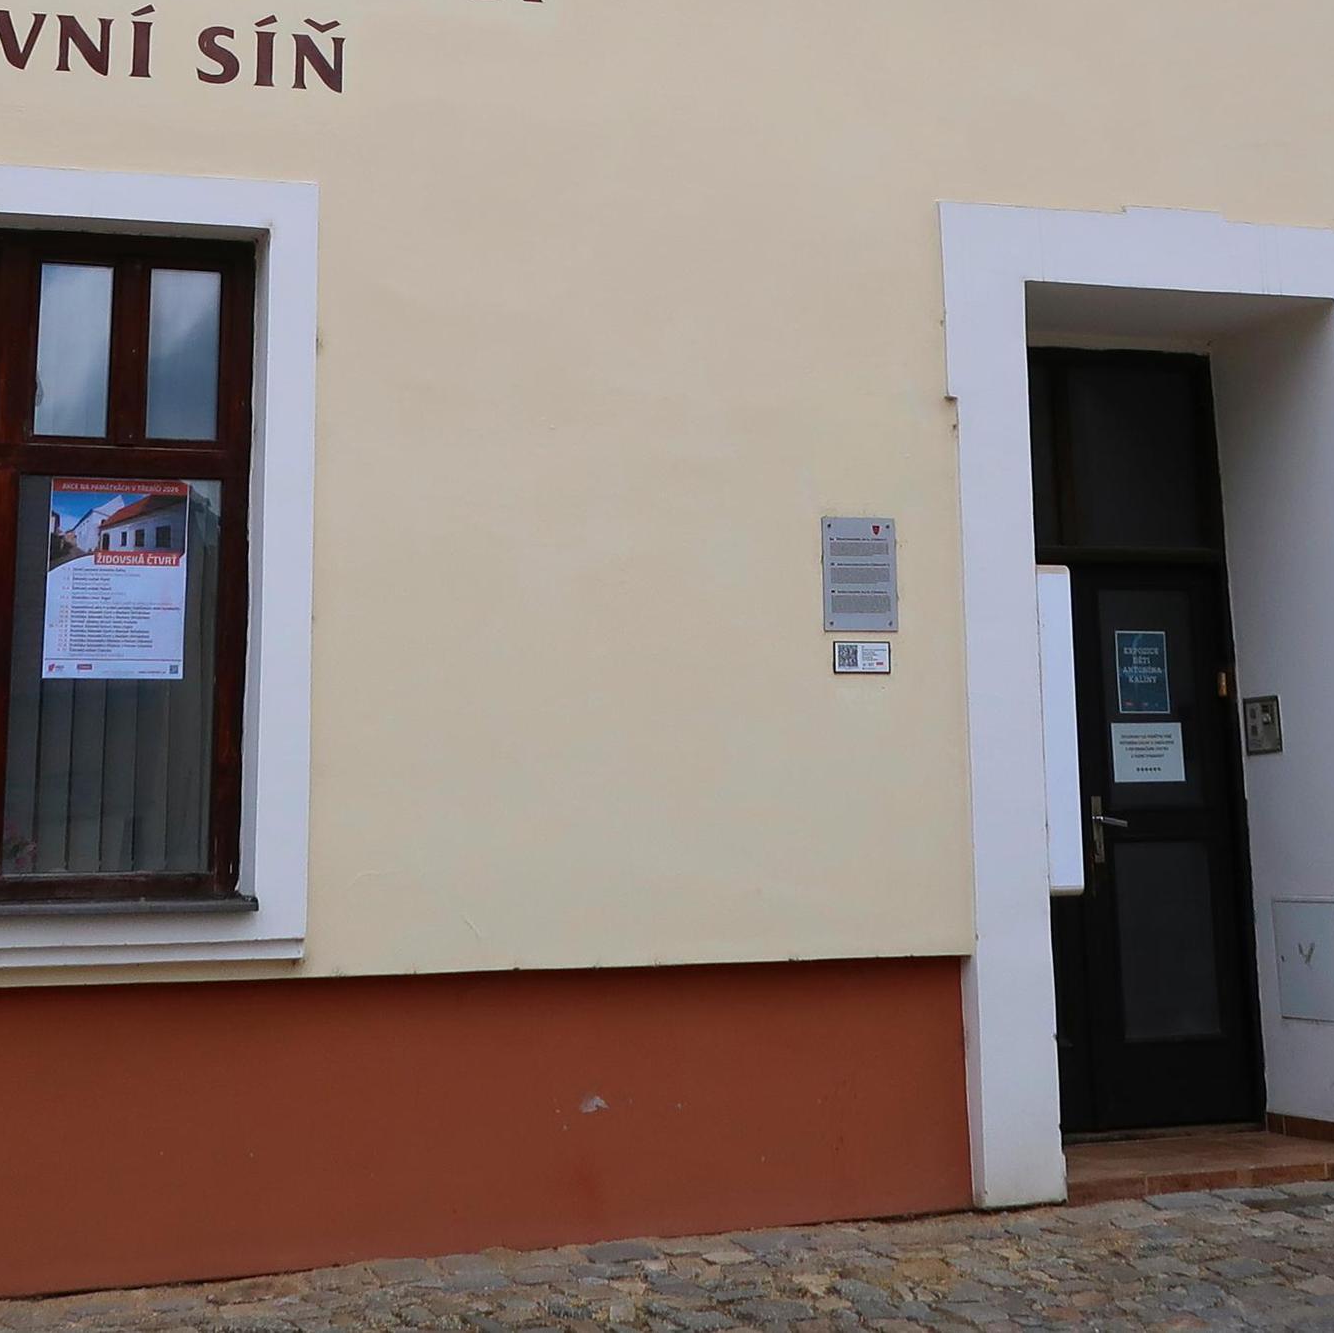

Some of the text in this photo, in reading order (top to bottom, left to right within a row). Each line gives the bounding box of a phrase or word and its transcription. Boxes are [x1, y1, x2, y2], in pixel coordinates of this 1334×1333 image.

[197, 14, 346, 94] SÍŇ
[97, 552, 177, 565] ŽIDOVSKÁ ČTVRŤ
